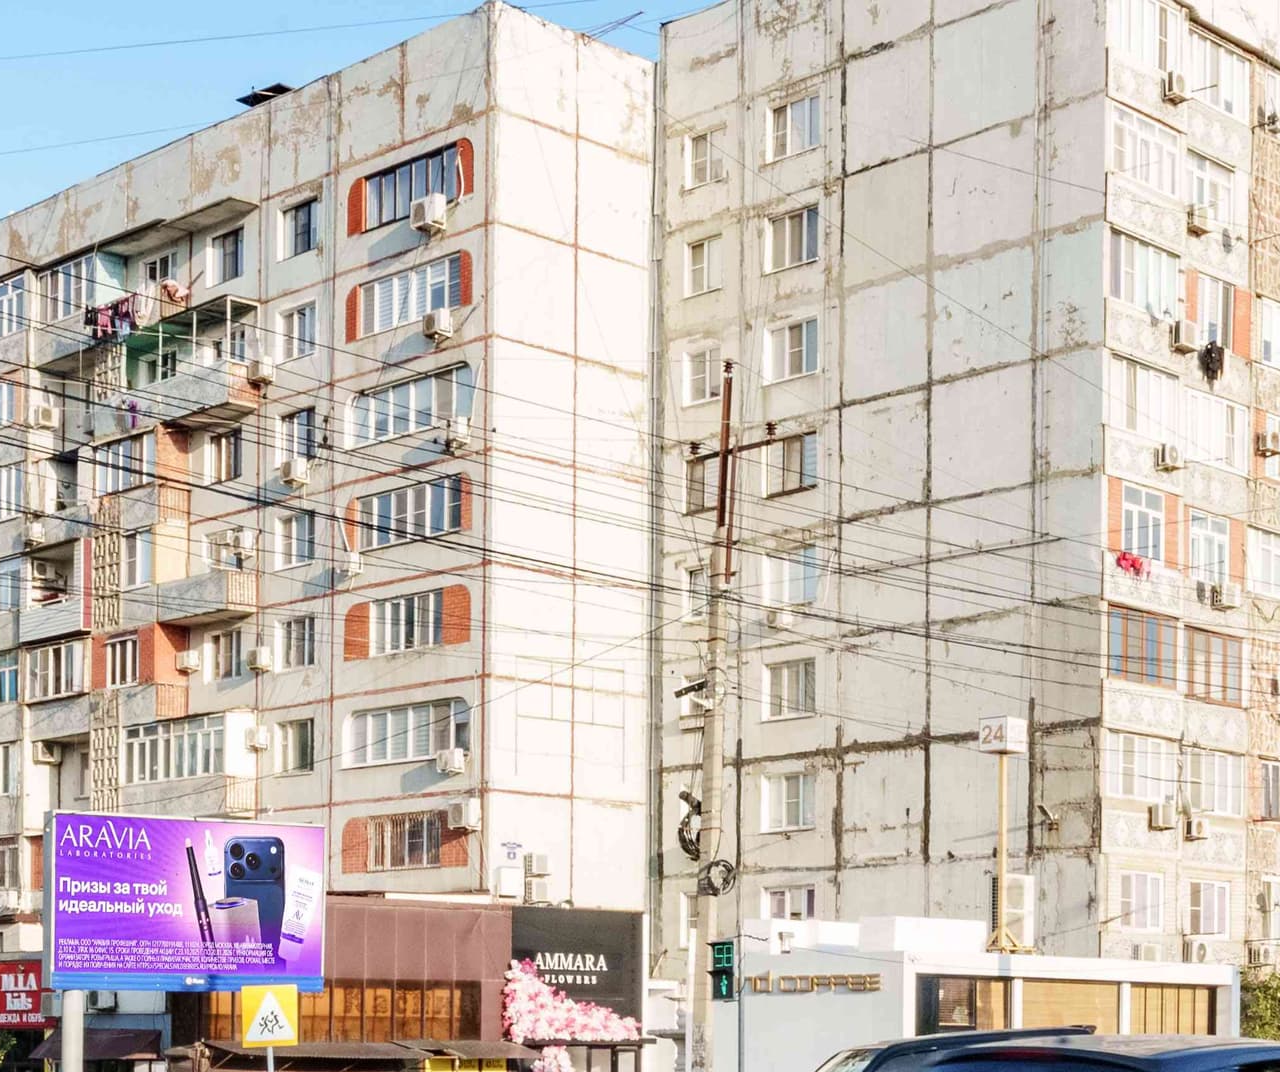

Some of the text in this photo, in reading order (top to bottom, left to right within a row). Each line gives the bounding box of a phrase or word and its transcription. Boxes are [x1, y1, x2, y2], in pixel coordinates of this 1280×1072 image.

[981, 724, 1004, 745] 24
[59, 820, 152, 850] ARAVIA
[59, 850, 152, 860] LABORATORIES
[59, 877, 167, 896] Призы за твой
[58, 898, 184, 918] идеальный уход
[535, 952, 608, 972] AMMARA
[714, 944, 733, 967] 58
[545, 974, 598, 984] FLOWERS
[734, 969, 772, 992] nd
